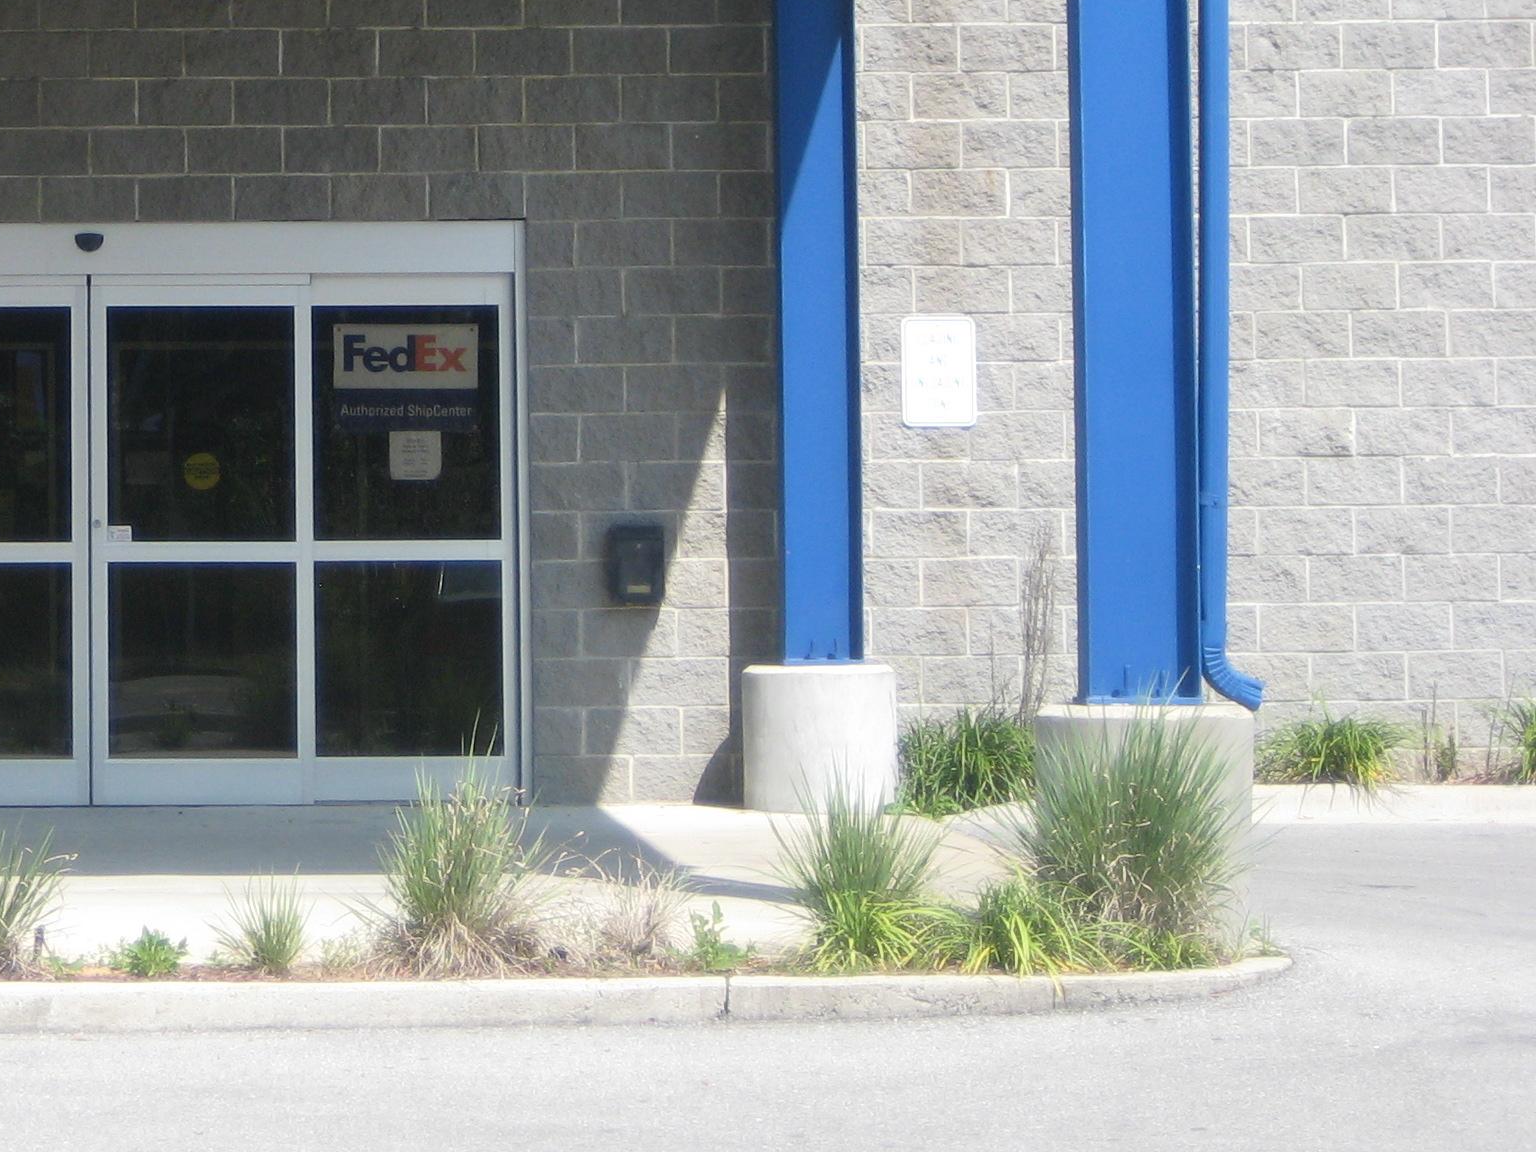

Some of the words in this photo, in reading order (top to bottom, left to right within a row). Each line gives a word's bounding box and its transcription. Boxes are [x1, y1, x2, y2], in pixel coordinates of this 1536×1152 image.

[342, 334, 469, 373] FedEx
[340, 403, 405, 417] Authorized
[407, 403, 473, 419] ShipCenter
